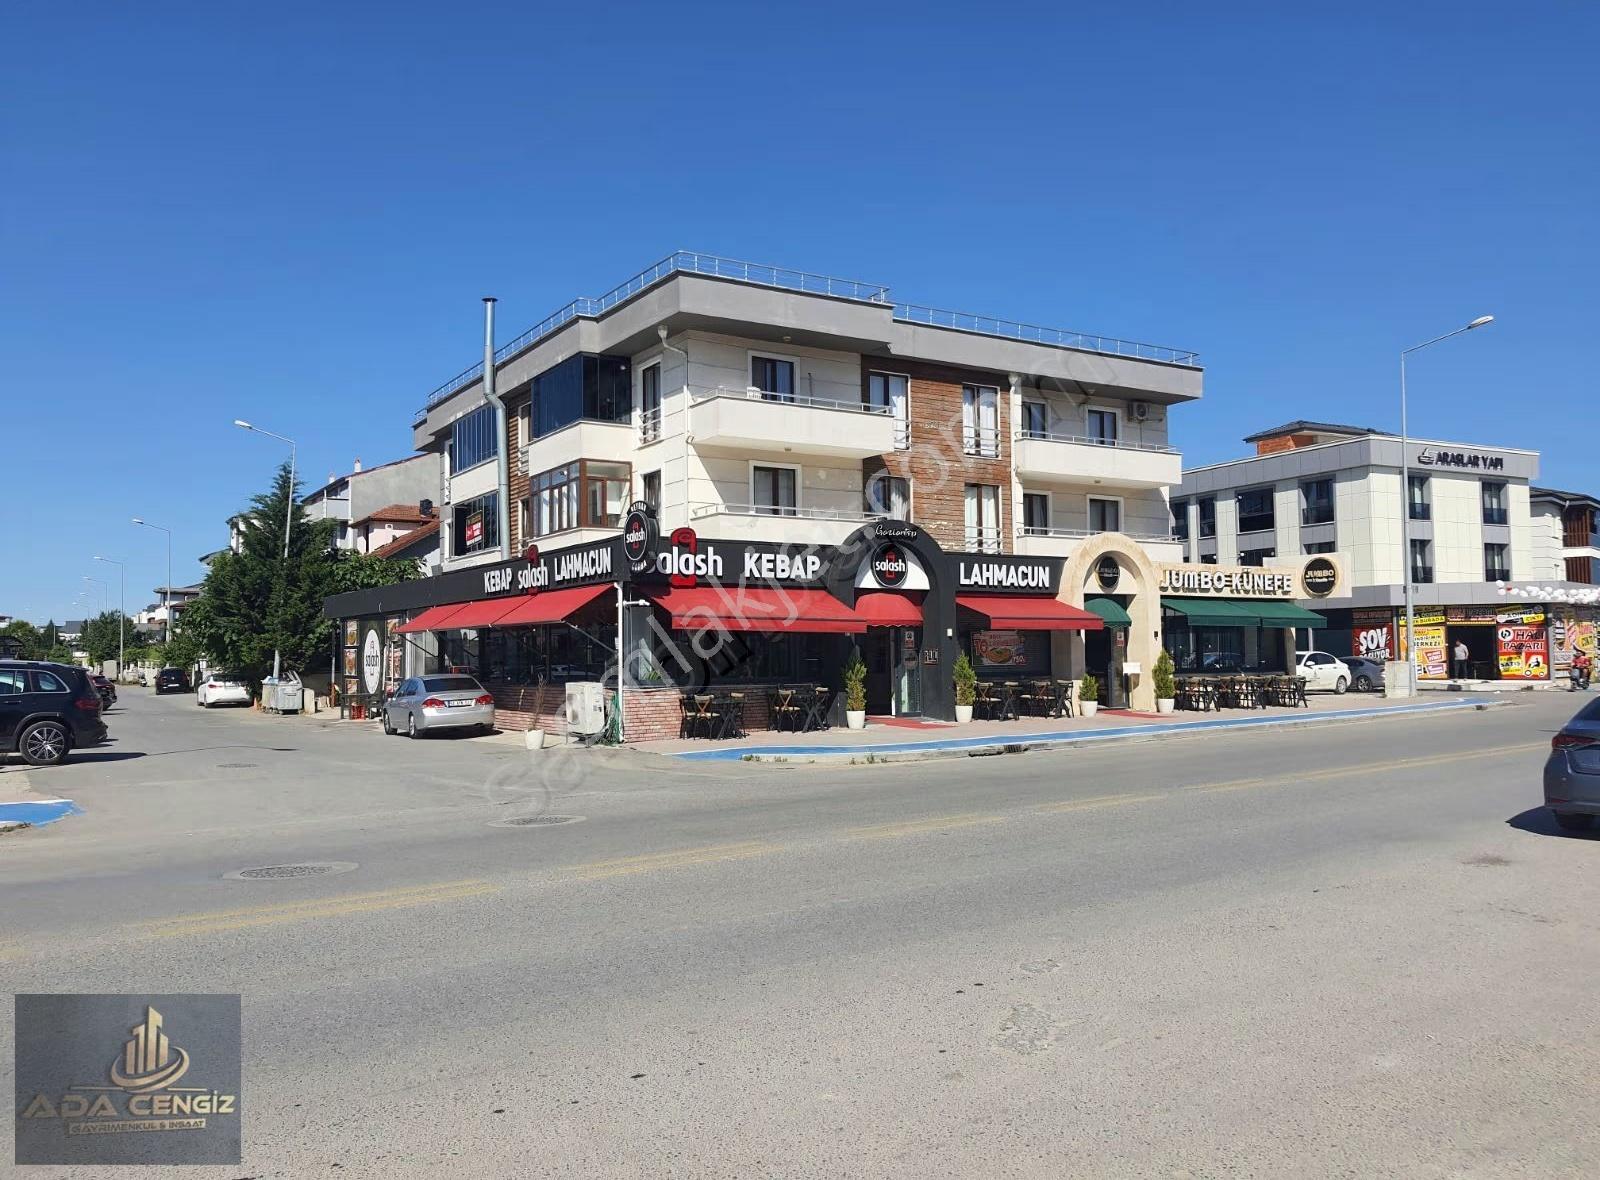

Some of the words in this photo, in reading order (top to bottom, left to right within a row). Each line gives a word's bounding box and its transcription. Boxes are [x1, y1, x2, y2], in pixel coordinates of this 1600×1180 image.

[626, 527, 646, 544] salash
[484, 567, 513, 593] KEBAP
[518, 558, 549, 589] salash
[554, 546, 612, 582] LAHMACUN
[646, 546, 723, 577] alash
[744, 552, 821, 579] KEBAP
[875, 559, 906, 571] salash
[959, 562, 1050, 588] LAHMACUN
[1160, 569, 1225, 589] JUMBO
[1231, 567, 1292, 591] KÜNEFE
[1503, 642, 1544, 650] PAZARI
[1515, 630, 1545, 640] HALI
